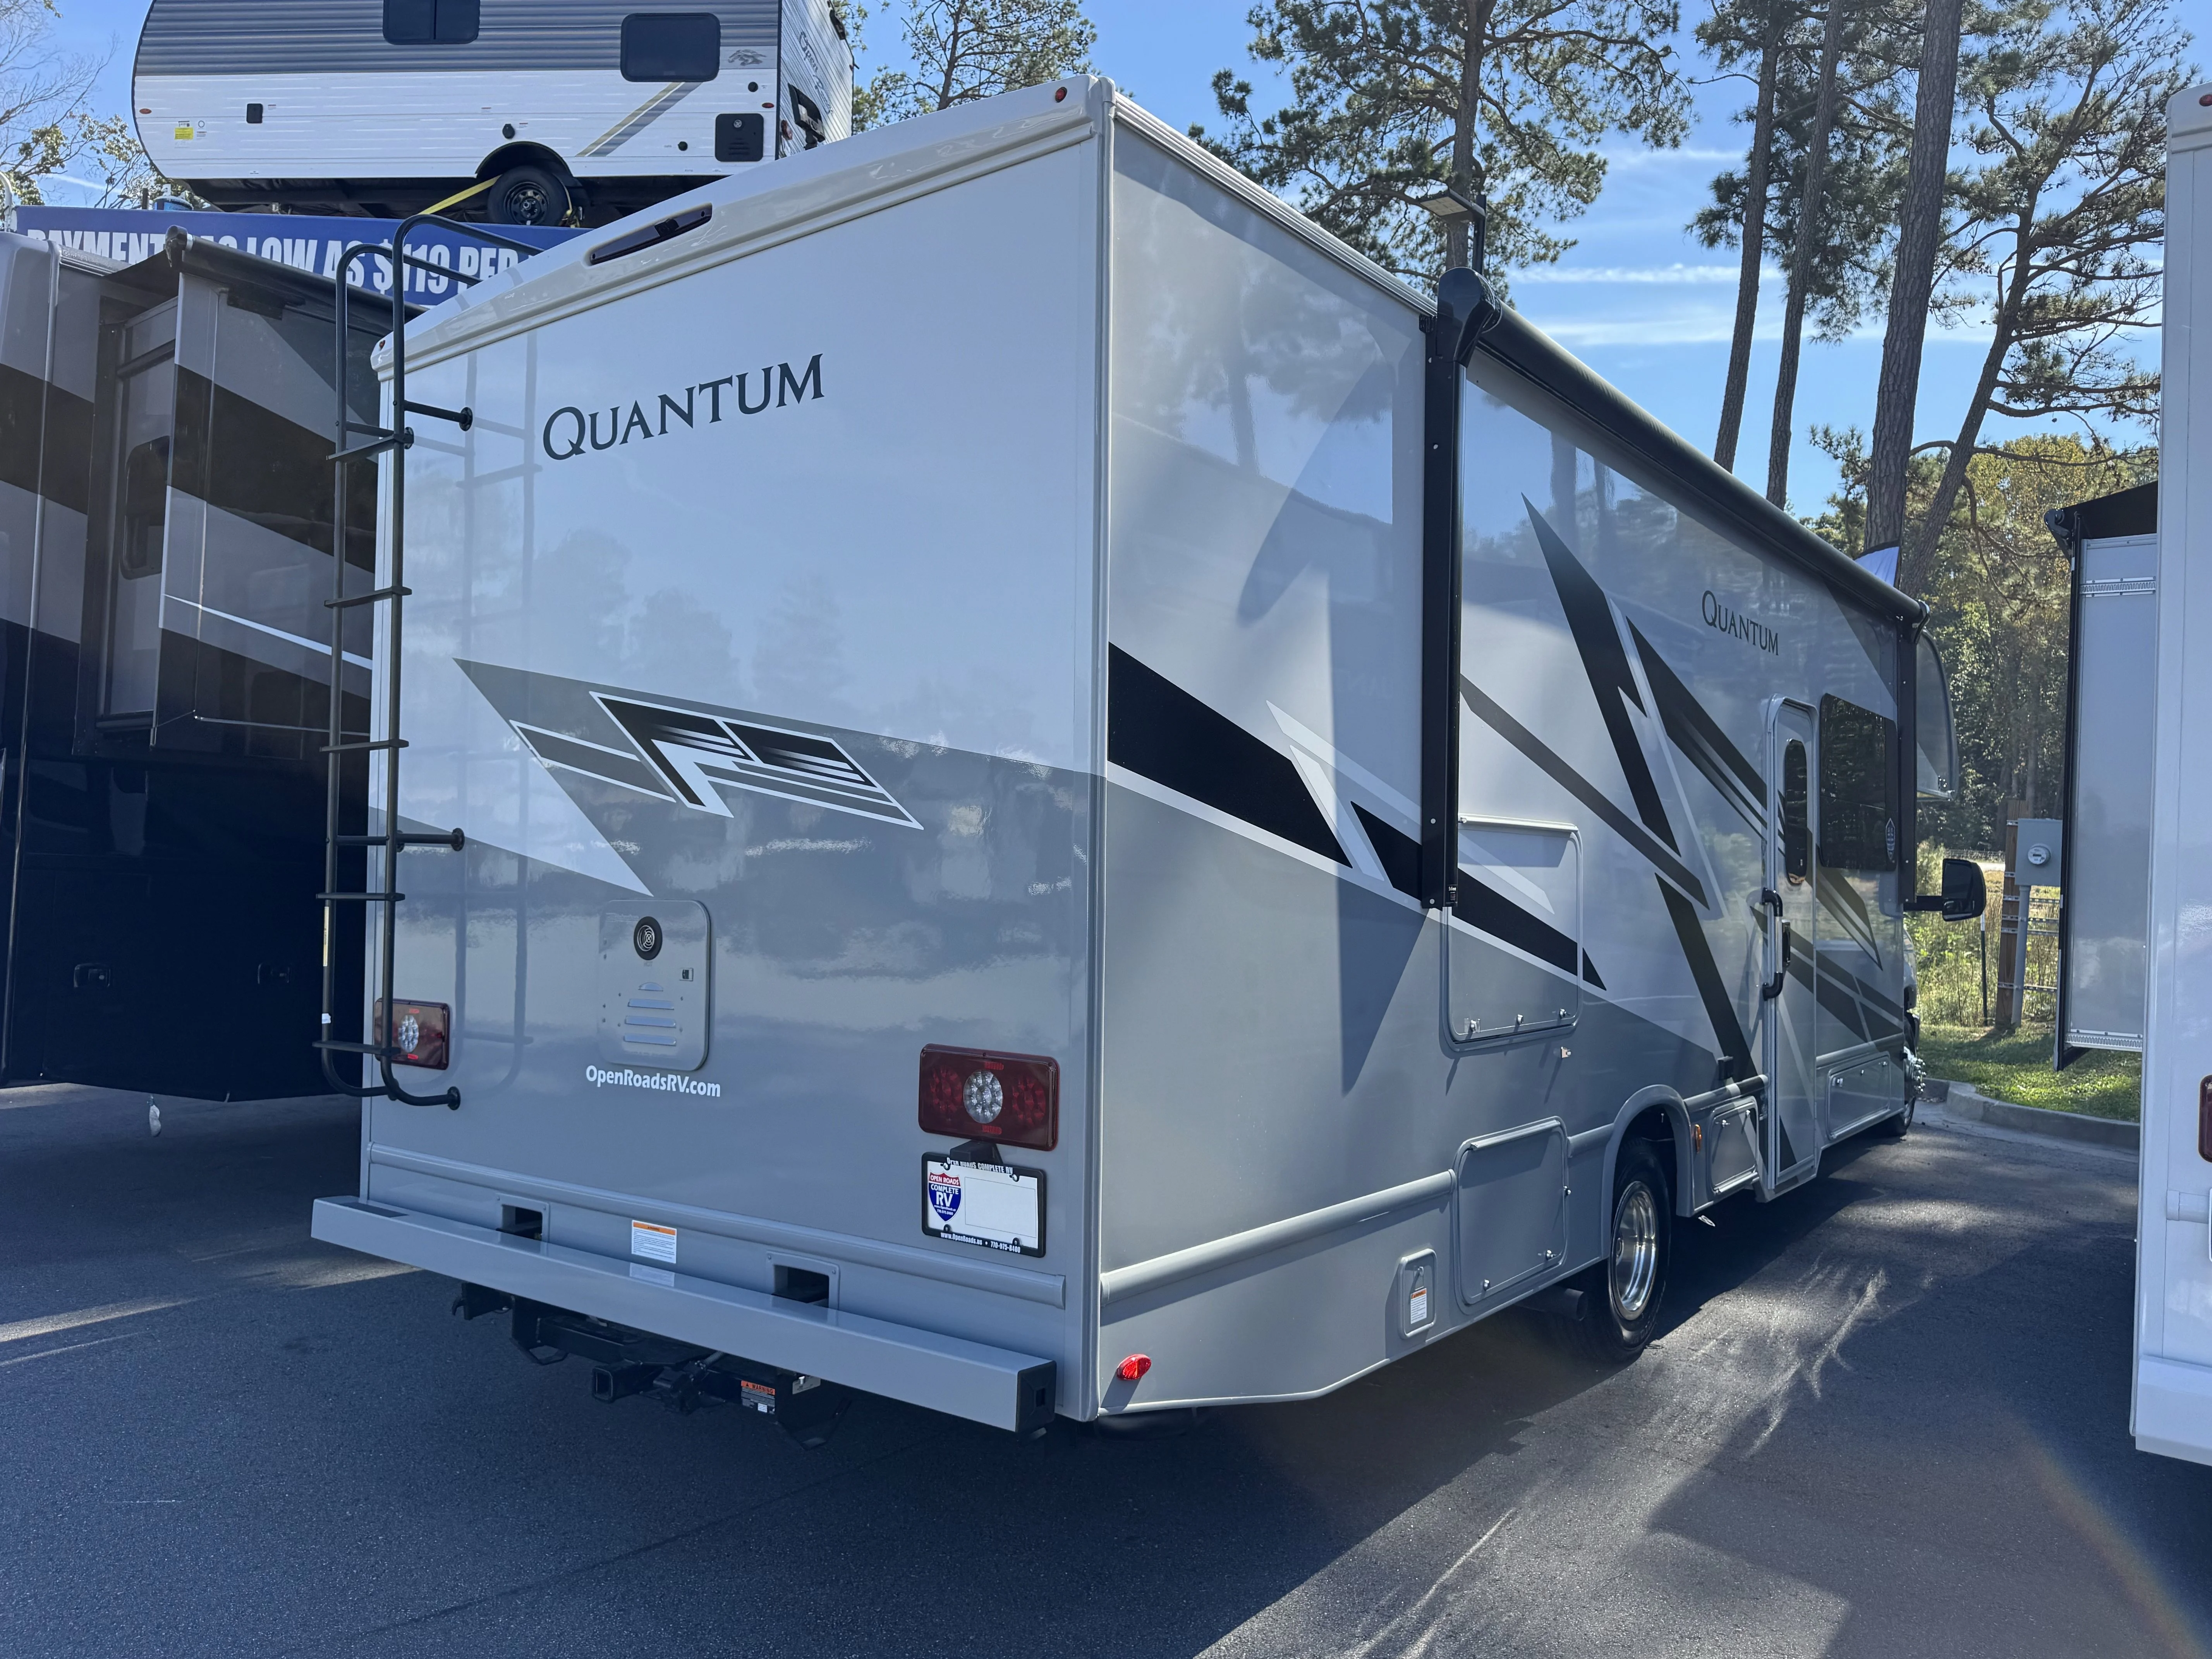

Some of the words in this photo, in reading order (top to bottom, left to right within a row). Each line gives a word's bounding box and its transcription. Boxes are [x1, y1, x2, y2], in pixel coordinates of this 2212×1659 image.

[373, 239, 450, 294] $119
[543, 353, 825, 460] QUANTUM
[1702, 590, 1779, 656] QUANTUM
[586, 1065, 721, 1097] OpenRoadsRV.com
[978, 1163, 1004, 1173] COMPLETE
[931, 1184, 959, 1195] COMPLETE
[936, 1191, 953, 1207] RV
[941, 1232, 982, 1245] www.OpenRoads.us
[991, 1241, 1021, 1254] 770-975-8400
[752, 1384, 773, 1393] WARNING
